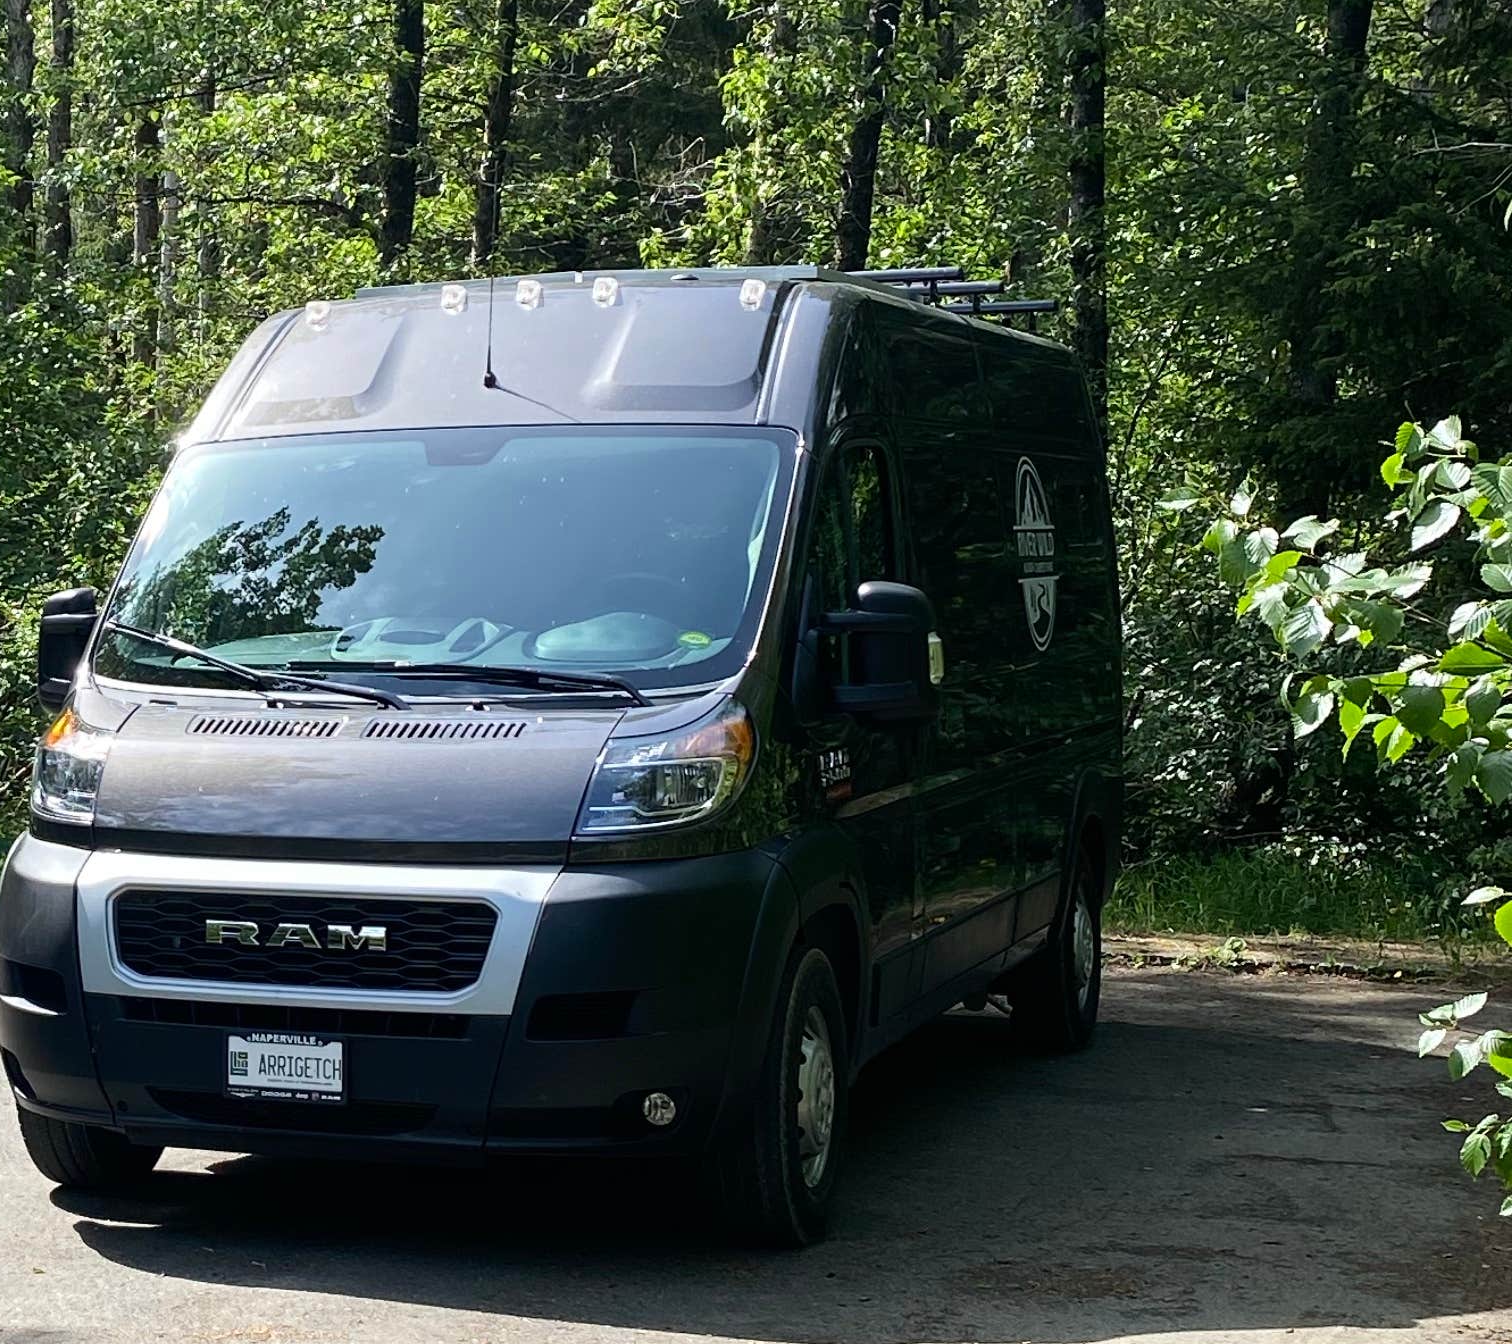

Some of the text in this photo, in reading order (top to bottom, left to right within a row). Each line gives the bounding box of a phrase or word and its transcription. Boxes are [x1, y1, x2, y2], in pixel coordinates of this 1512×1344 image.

[205, 919, 387, 951] RAM
[251, 1033, 317, 1045] NAPERVILLE
[258, 1053, 342, 1081] ARRIGETCH
